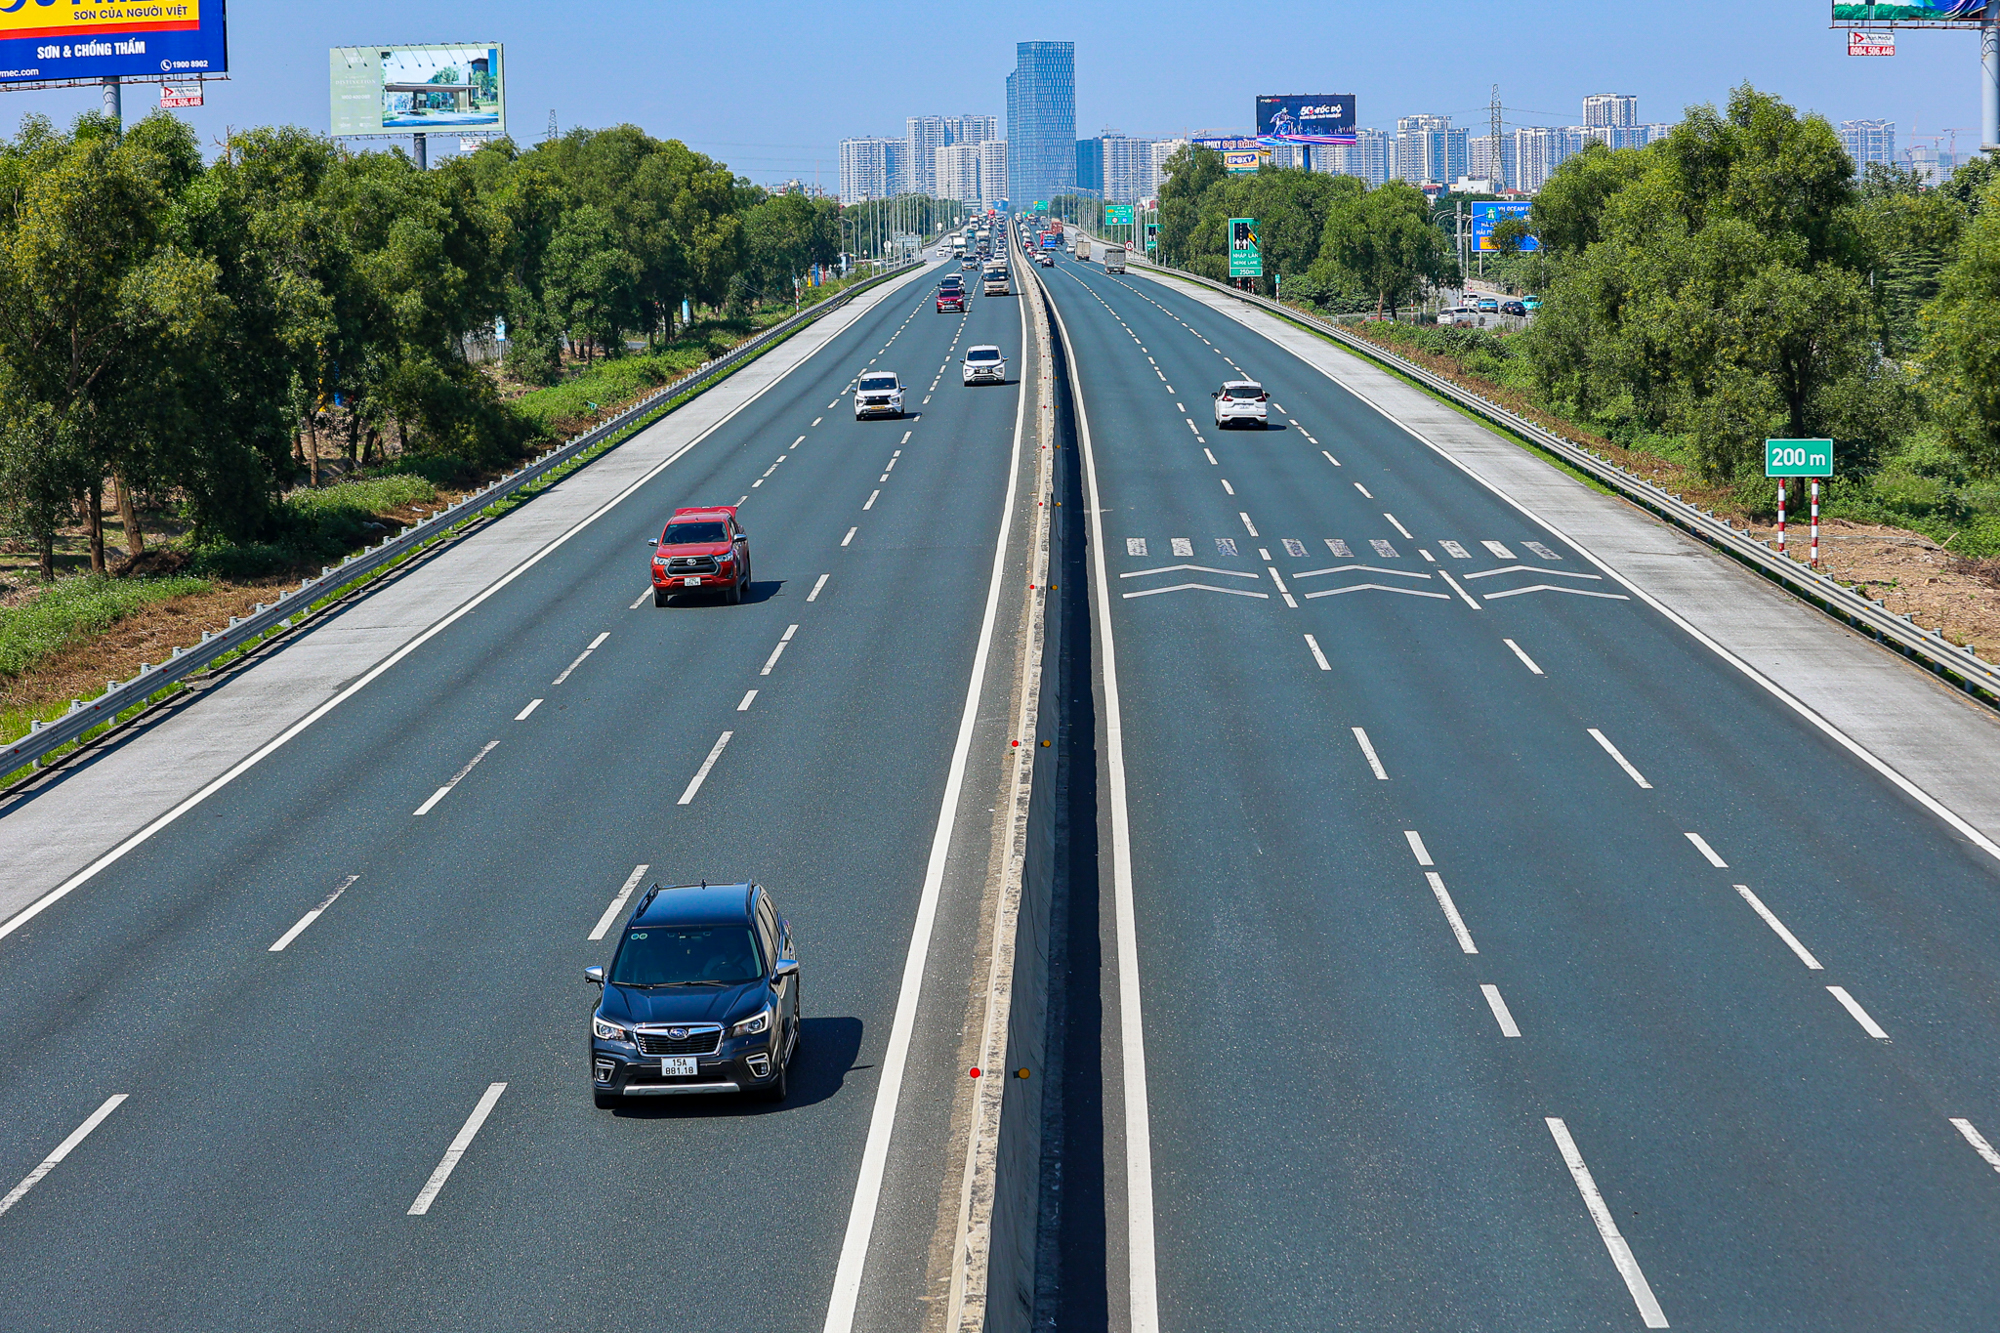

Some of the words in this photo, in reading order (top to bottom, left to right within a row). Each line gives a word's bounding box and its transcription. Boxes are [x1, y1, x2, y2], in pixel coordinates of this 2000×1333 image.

[73, 10, 96, 20] SƠN
[99, 7, 123, 19] CỦA
[126, 5, 162, 18] NGƯỜI
[166, 4, 188, 18] VIỆT
[37, 45, 60, 59] SƠN
[62, 45, 71, 58] &
[74, 39, 112, 57] CHỐNG
[114, 37, 146, 55] THẤM
[1850, 46, 1894, 56] 0904.506.446
[190, 60, 208, 68] 8902
[1772, 448, 1806, 466] 200
[1810, 454, 1826, 466] m
